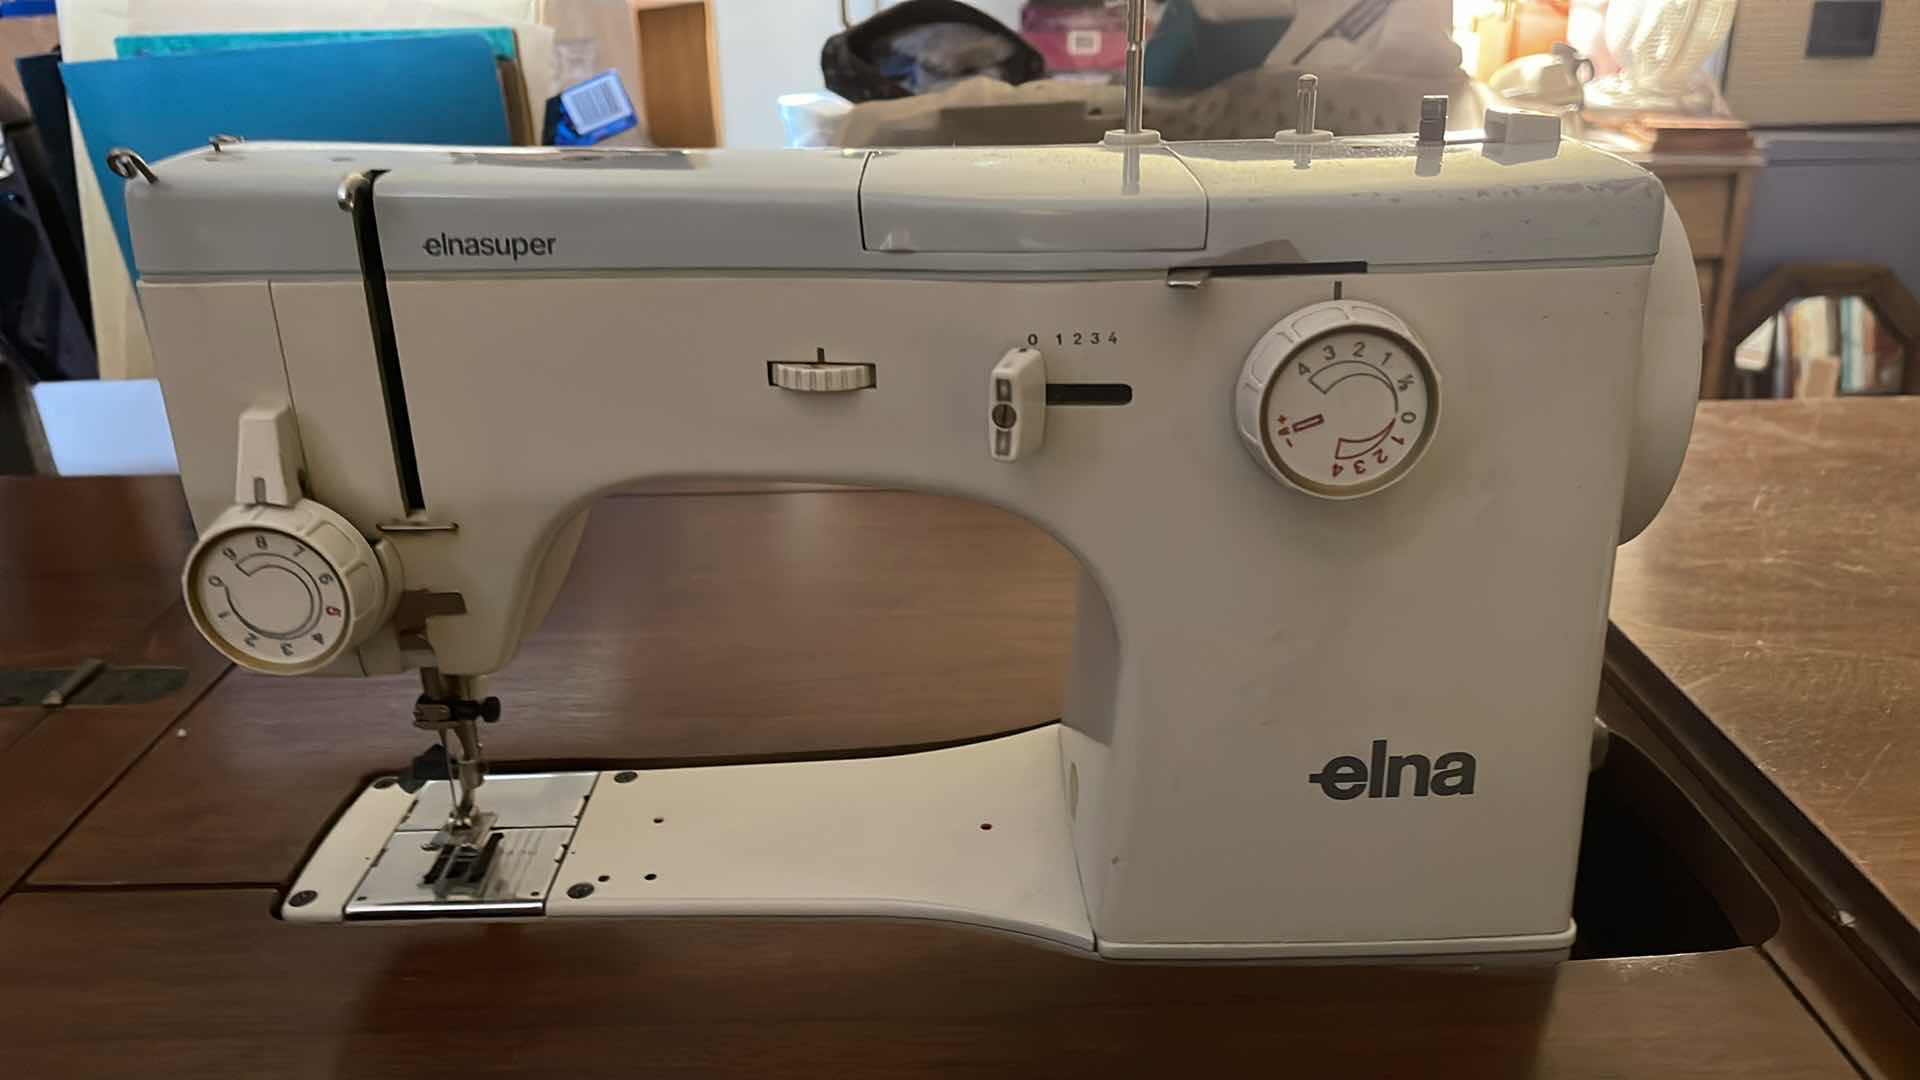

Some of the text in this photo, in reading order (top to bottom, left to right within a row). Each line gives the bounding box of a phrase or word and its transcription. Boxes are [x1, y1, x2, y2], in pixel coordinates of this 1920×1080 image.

[422, 232, 557, 261] elnasuper
[1027, 331, 1118, 346] 0 1 2 3 4
[1322, 345, 1336, 360] 3
[1352, 341, 1366, 357] 2
[1380, 352, 1393, 366] 1
[1297, 362, 1312, 376] 4
[1401, 411, 1417, 424] 0
[1390, 435, 1405, 446] 1
[1372, 448, 1388, 464] 2
[1331, 463, 1344, 477] 4
[1353, 459, 1367, 475] 3
[255, 535, 268, 550] 8
[222, 547, 238, 561] 9
[293, 544, 306, 557] 7
[325, 606, 342, 618] 5
[243, 632, 259, 648] 2
[312, 633, 325, 646] 4
[280, 643, 294, 656] 3
[1308, 739, 1476, 801] elna
